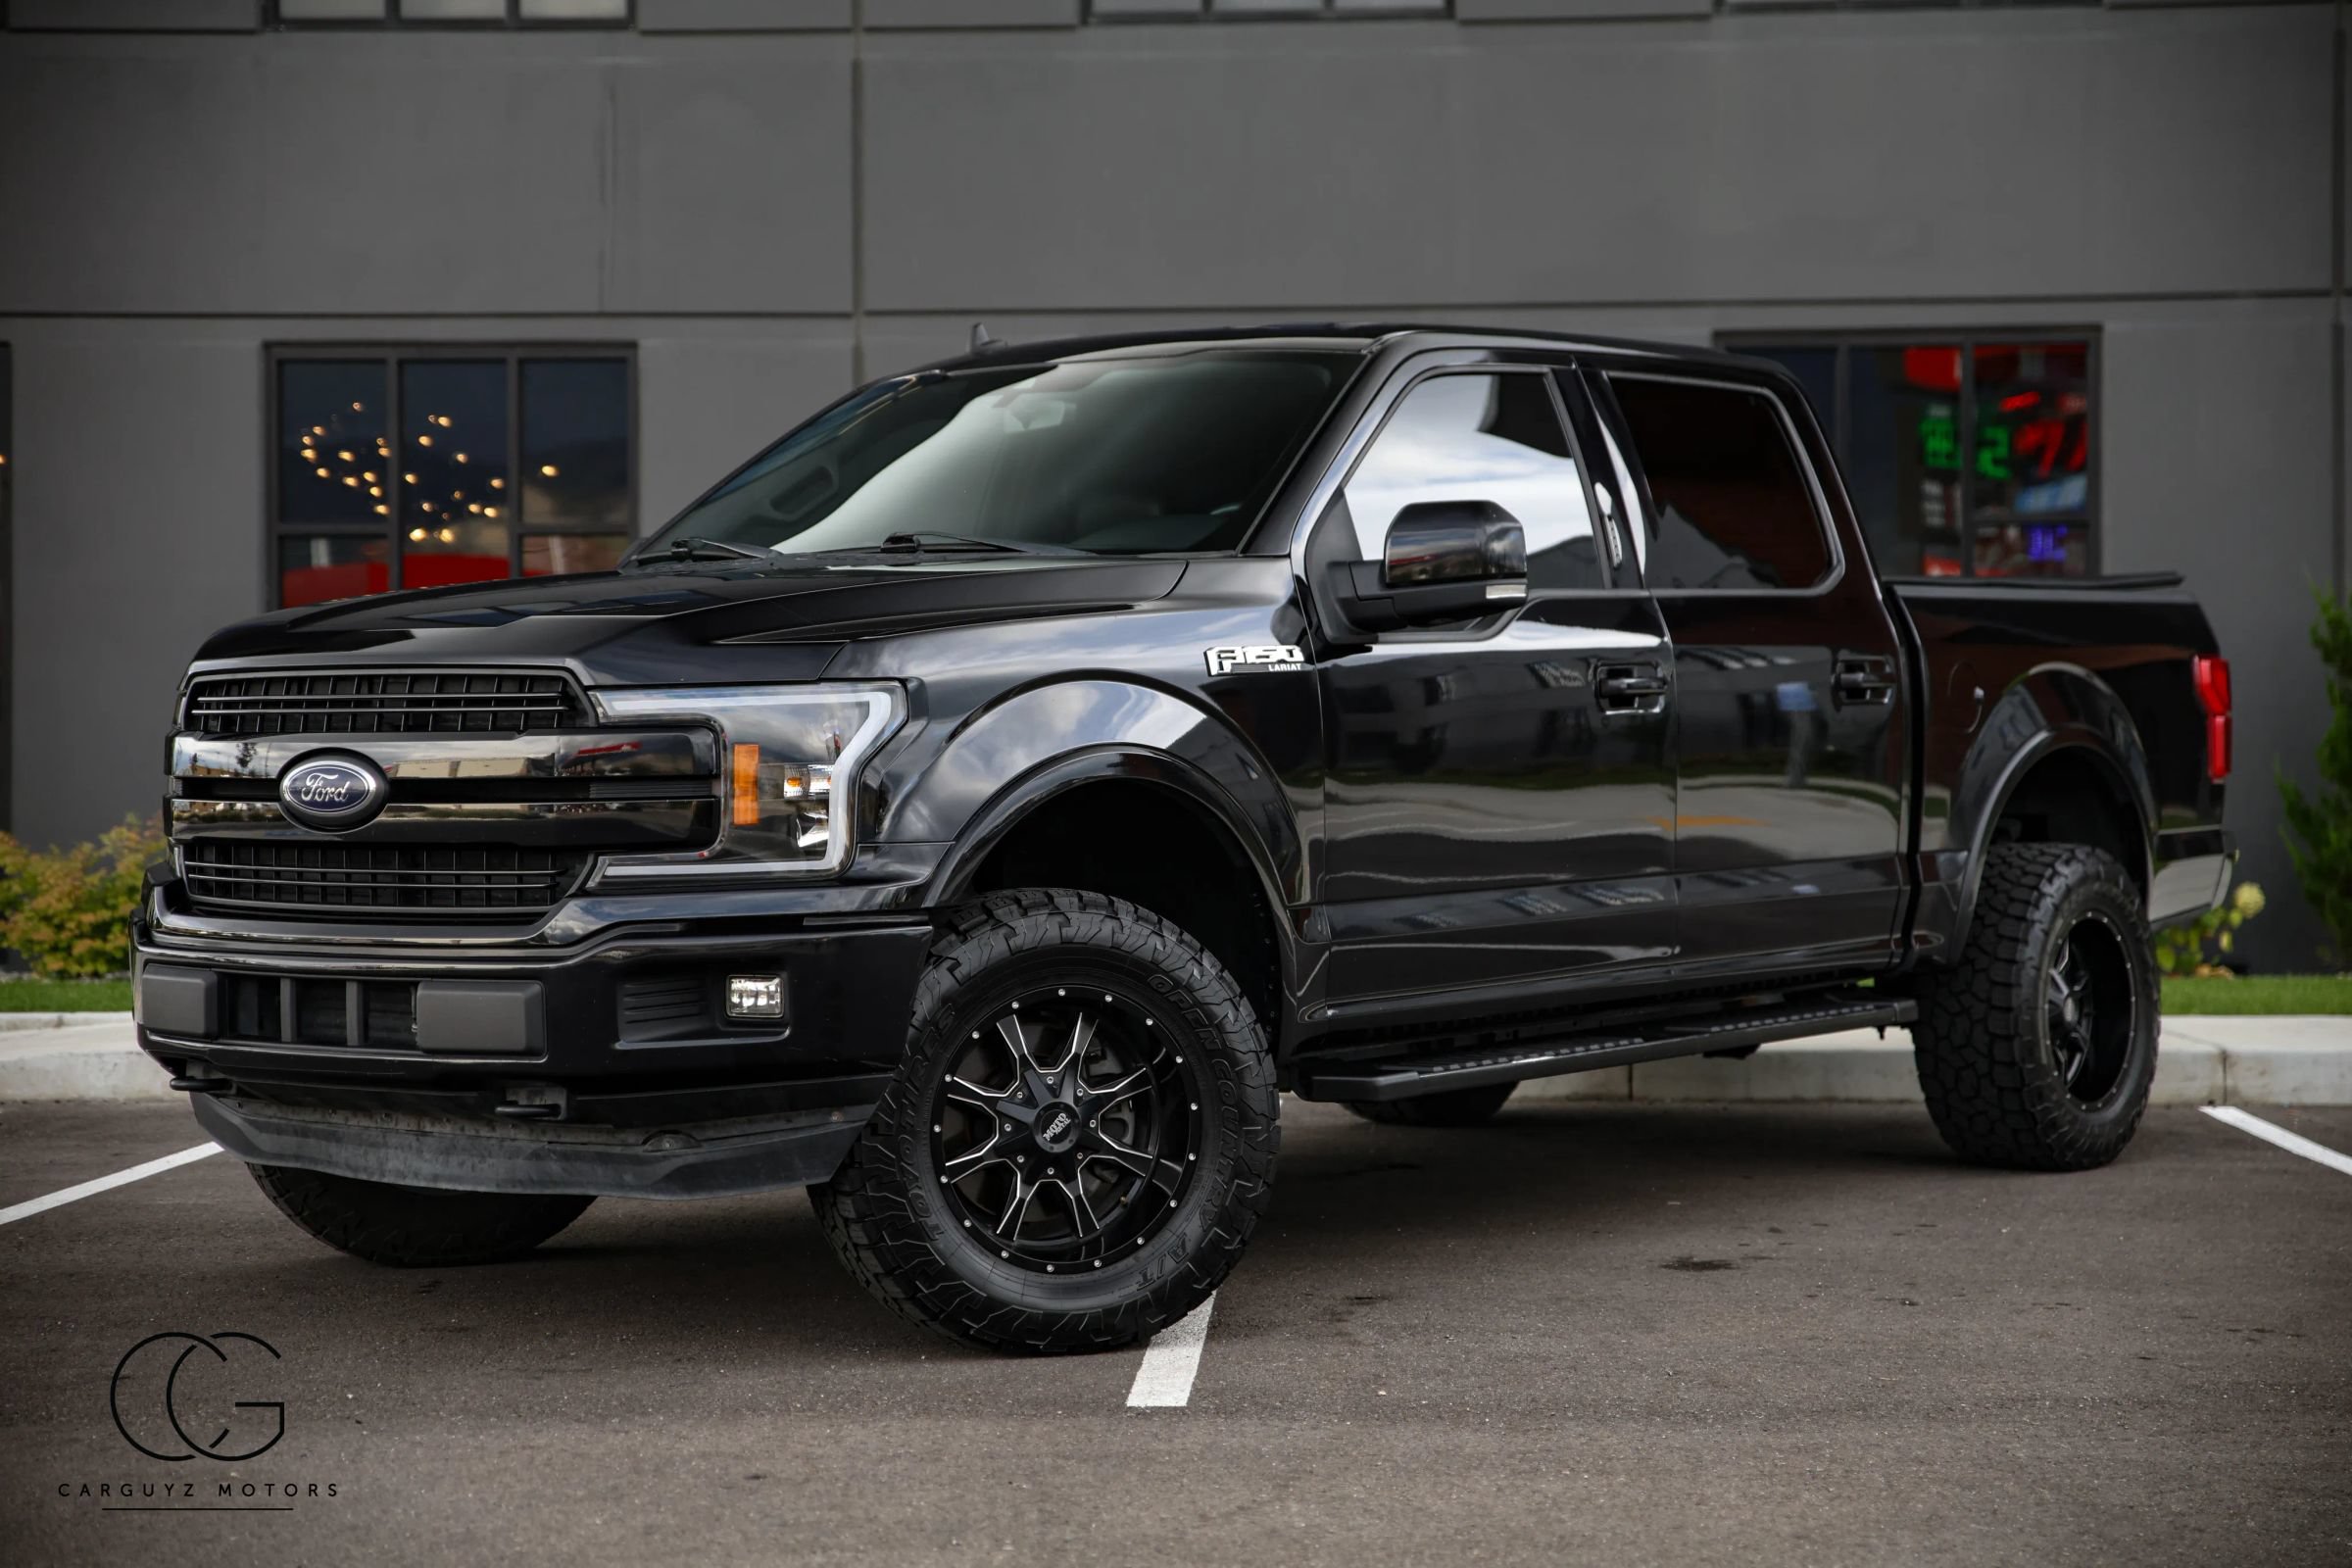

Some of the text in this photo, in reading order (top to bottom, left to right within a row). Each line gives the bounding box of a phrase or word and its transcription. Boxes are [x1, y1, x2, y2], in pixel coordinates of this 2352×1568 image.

[1268, 662, 1301, 672] LARIAT
[301, 772, 351, 803] Ford
[1147, 973, 1222, 1051] OPEN
[1199, 1057, 1239, 1232] COUNTRY
[897, 1003, 956, 1242] TOYO TIRES
[1043, 1112, 1066, 1142] MOTO
